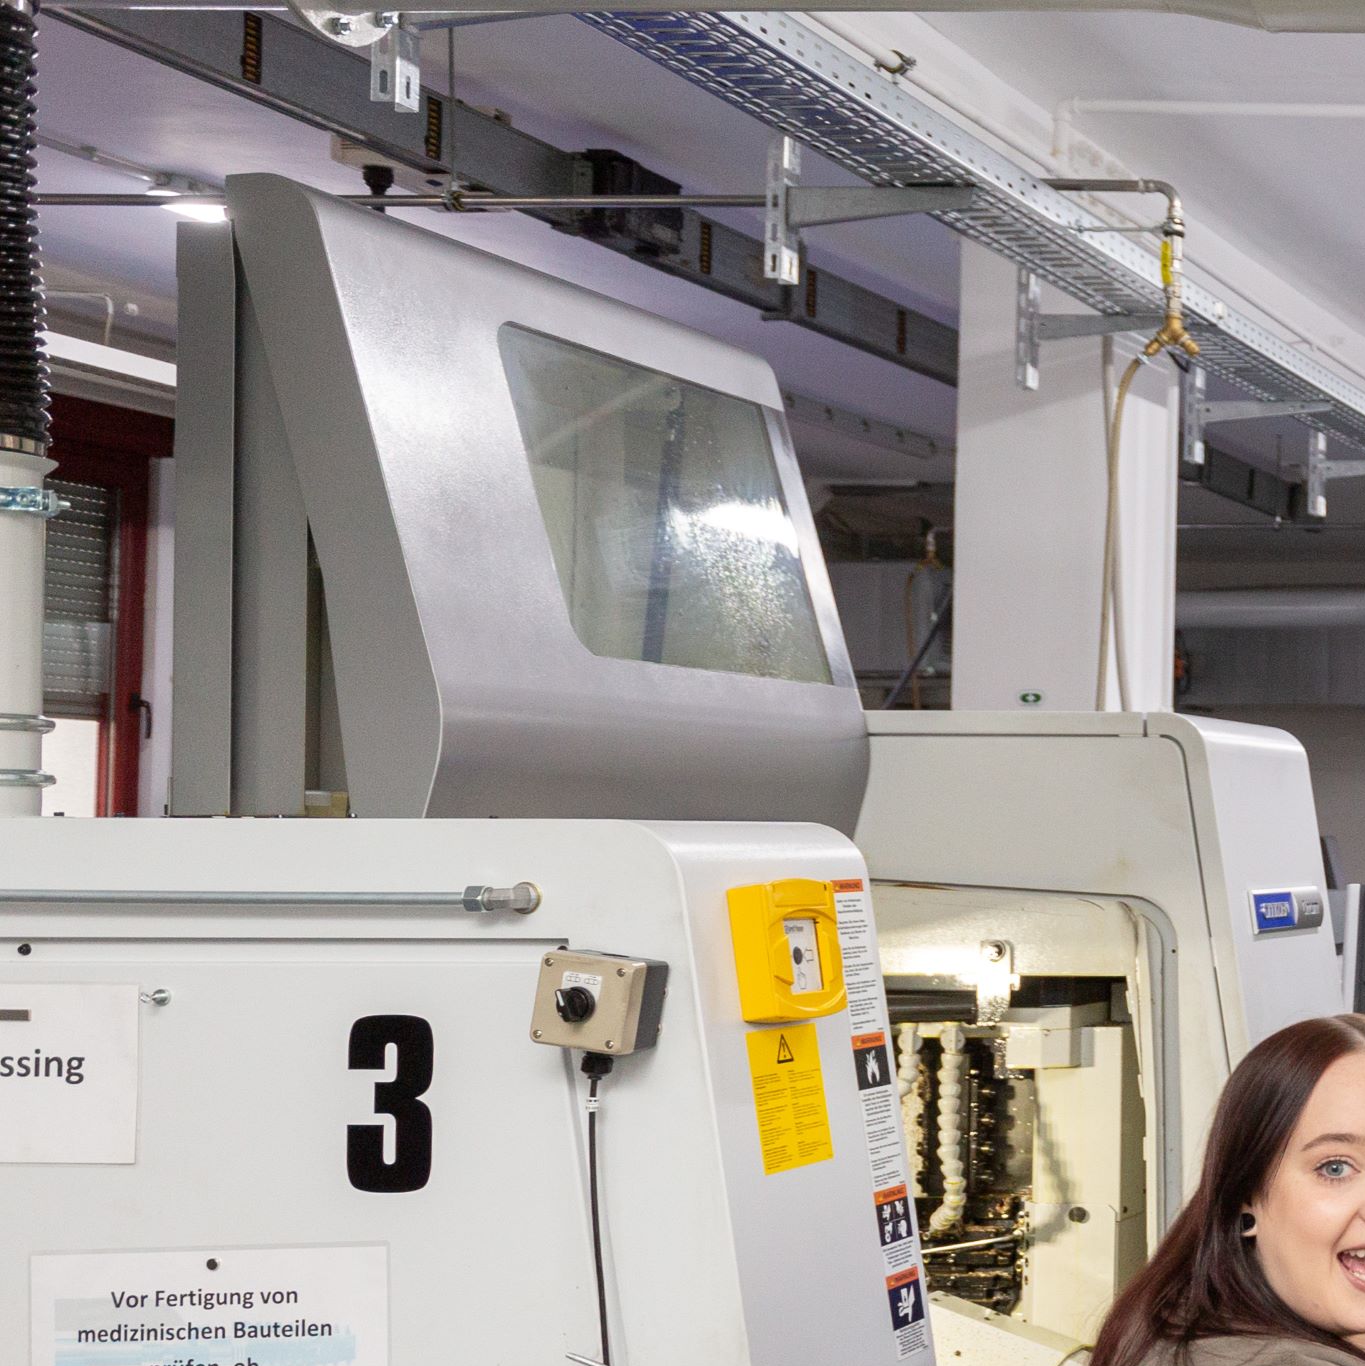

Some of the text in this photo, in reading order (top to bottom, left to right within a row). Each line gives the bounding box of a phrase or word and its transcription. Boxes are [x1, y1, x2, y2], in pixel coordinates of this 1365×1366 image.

[0, 1049, 85, 1084] ssing
[347, 1015, 433, 1193] 3
[111, 1289, 297, 1310] Vor Fertigung von
[78, 1319, 331, 1342] medizinischen Bauteilen
